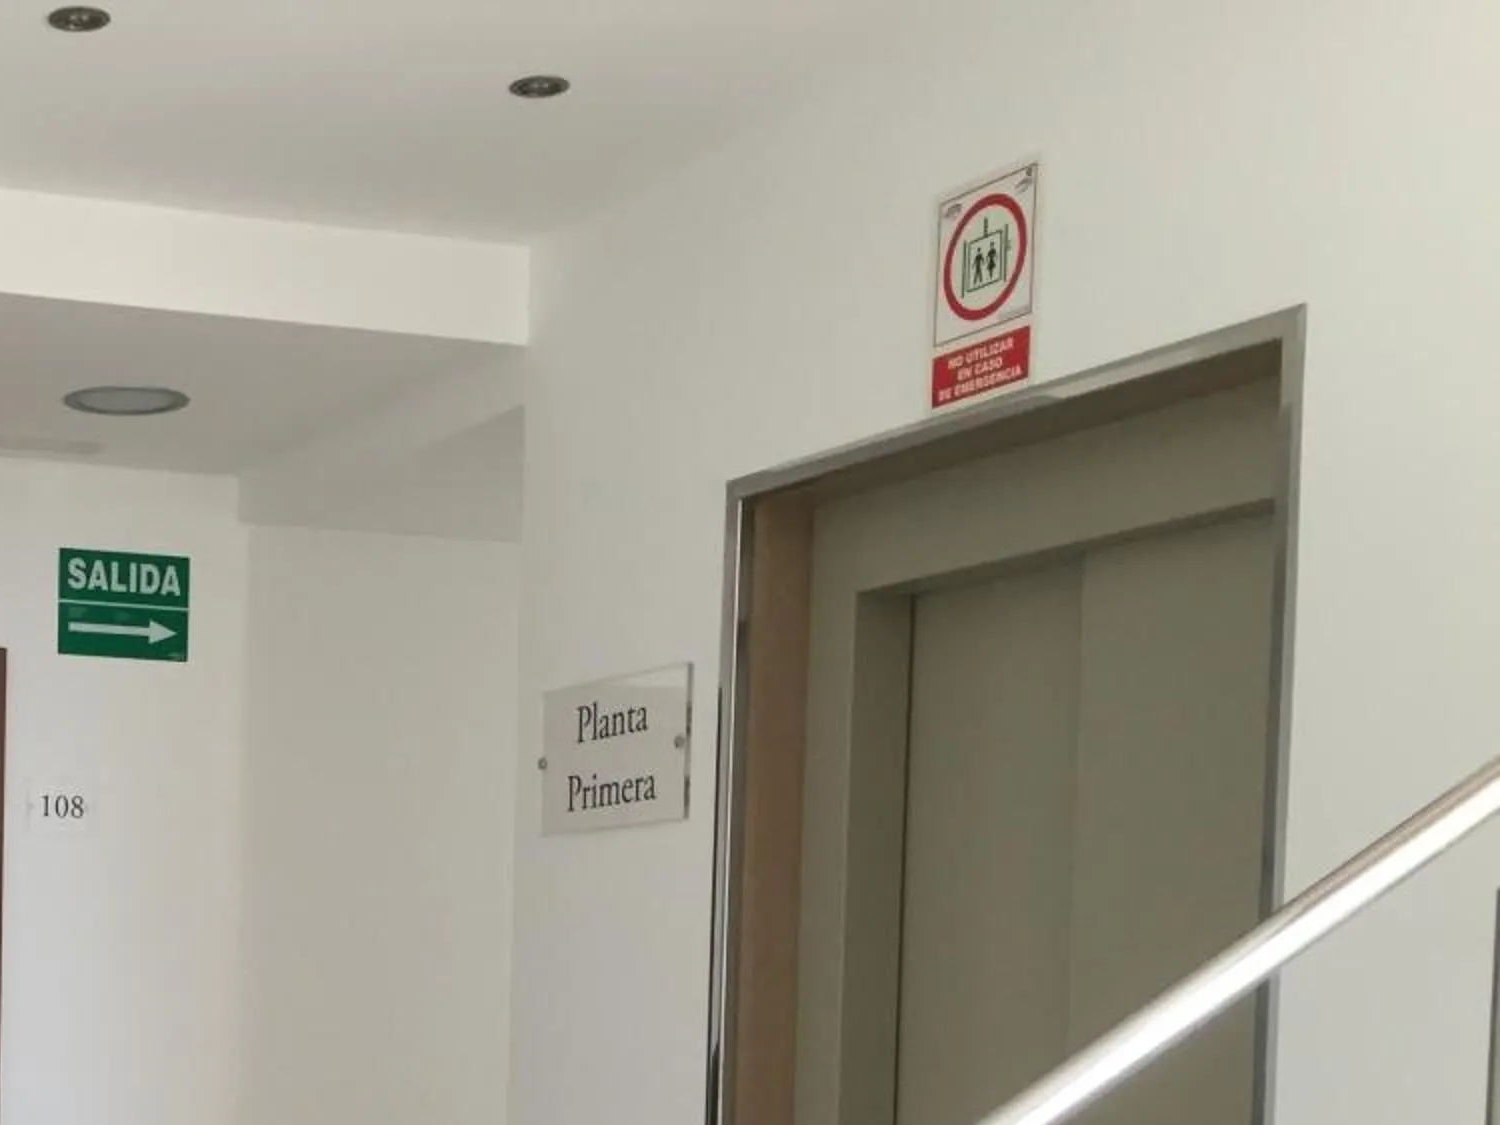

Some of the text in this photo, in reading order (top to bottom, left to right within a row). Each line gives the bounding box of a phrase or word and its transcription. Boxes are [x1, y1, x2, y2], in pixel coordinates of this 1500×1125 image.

[947, 337, 1014, 370] NO UTILIZAR
[958, 356, 1003, 381] EN CASO
[66, 557, 181, 596] SALIDA
[576, 701, 649, 744] Planta
[41, 794, 85, 819] 108
[567, 773, 657, 812] Primera
